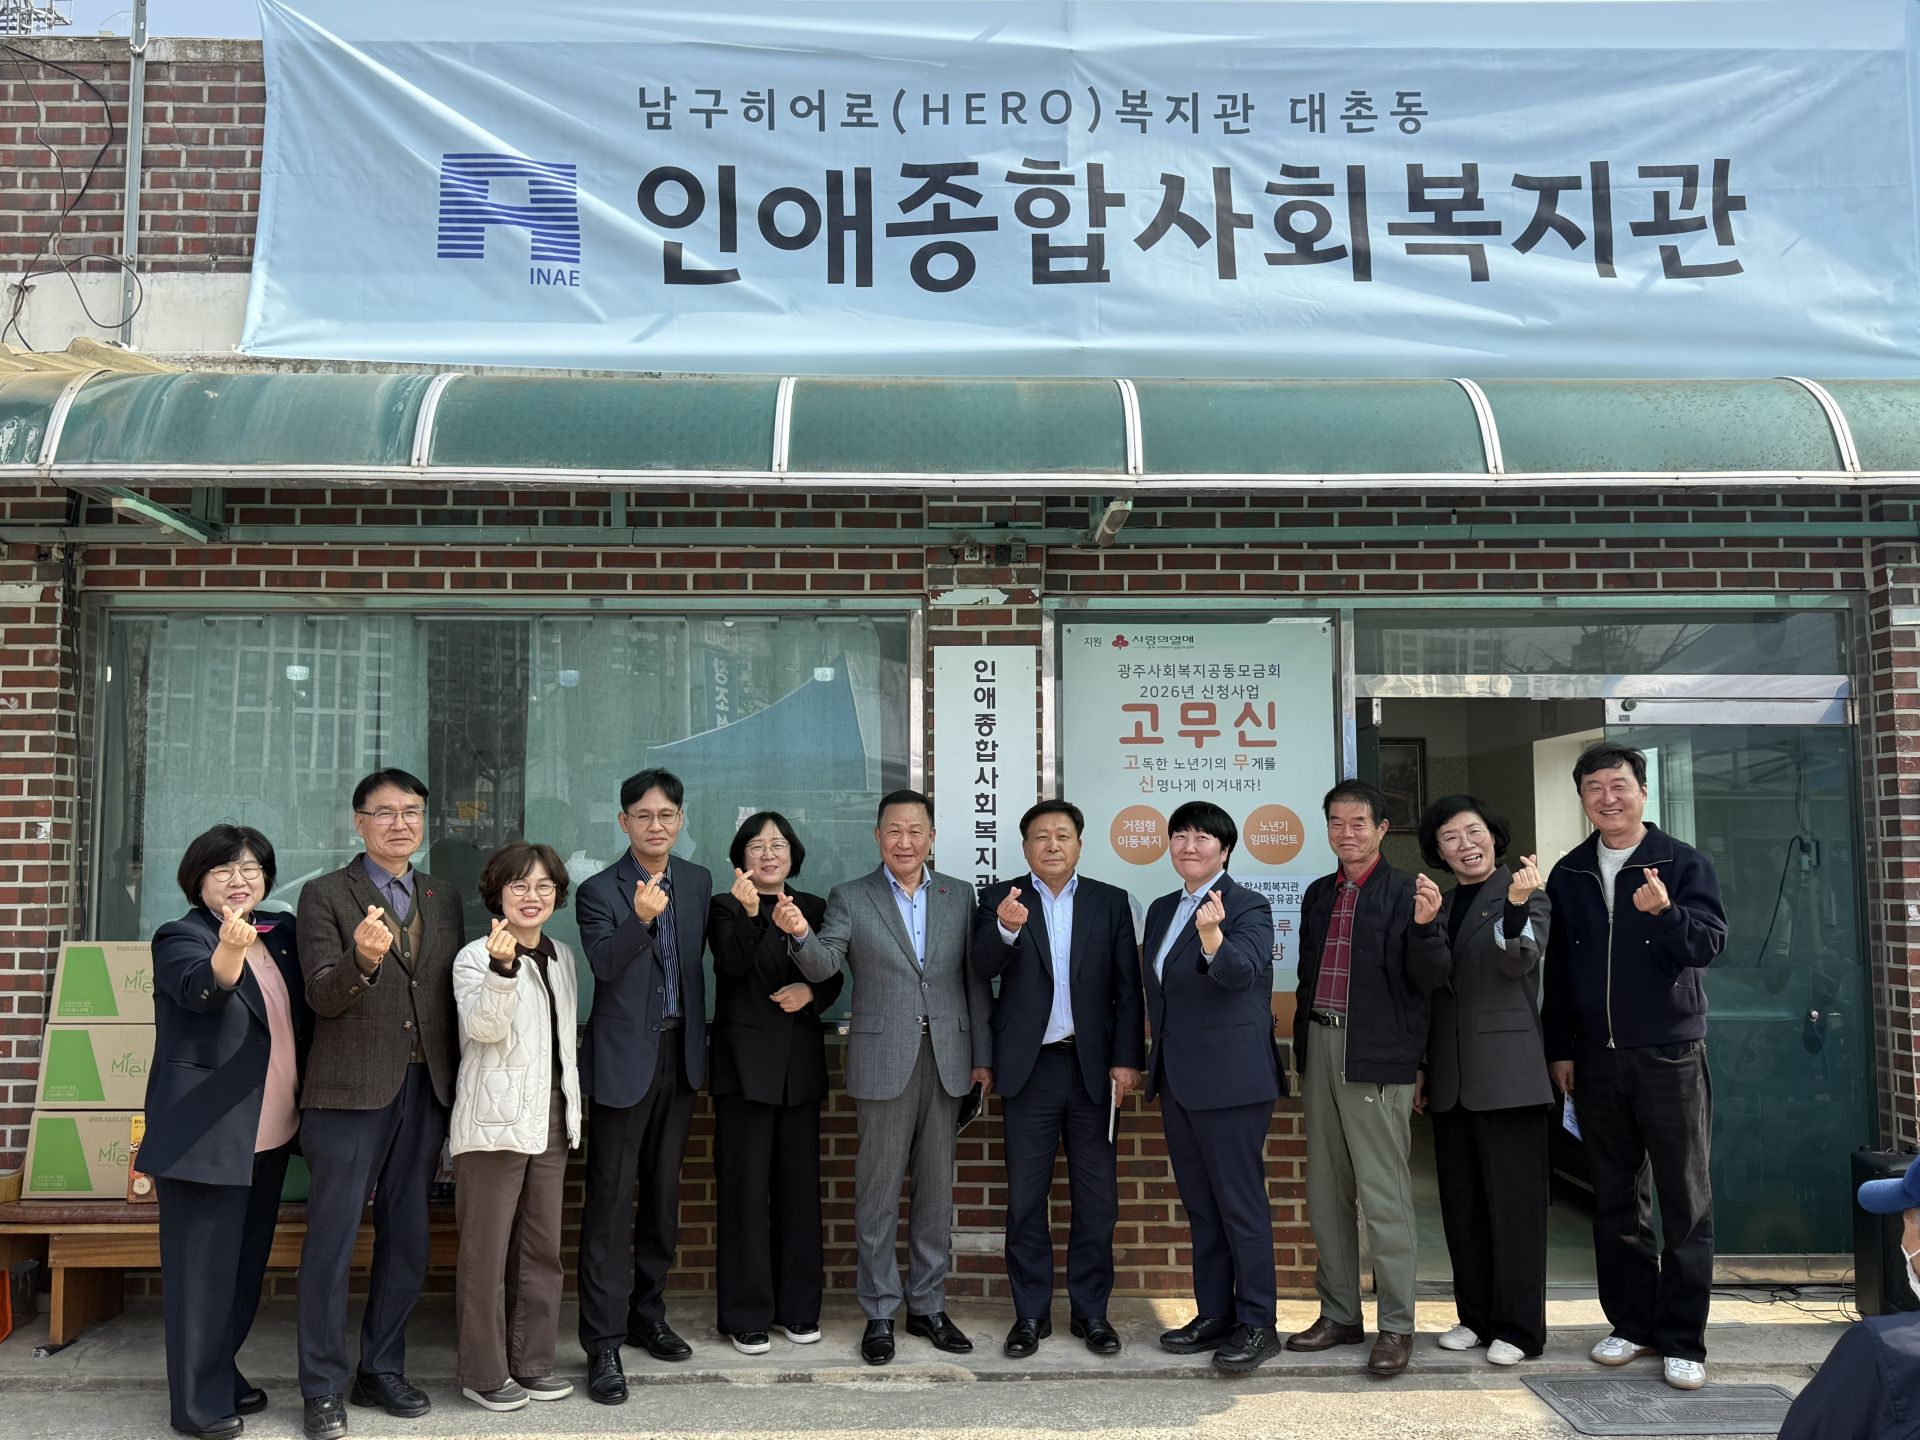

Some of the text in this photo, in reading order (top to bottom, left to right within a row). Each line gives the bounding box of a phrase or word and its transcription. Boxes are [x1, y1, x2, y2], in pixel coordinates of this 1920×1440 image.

[638, 85, 1430, 135] 남구히어로(HERO)복지관 대촌동
[637, 157, 1747, 293] 인애종합사회복지관
[529, 267, 580, 287] INAE
[1084, 635, 1194, 648] 지원 사랑의열매
[1117, 663, 1281, 679] 광주사회복지공동모금회
[1139, 684, 1259, 700] 2026년 신청사업
[1118, 700, 1278, 749] 고무신
[1123, 754, 1276, 772] 고독한 노년기의 무게를
[1138, 775, 1261, 793] 신명나게 이겨내자!
[1122, 819, 1156, 833] 거점형
[1259, 820, 1288, 832] 노년기
[1117, 834, 1162, 848] 이동복지
[1250, 834, 1299, 846] 임파워먼트
[1273, 919, 1293, 937] 루
[125, 969, 153, 993] Mie
[111, 1052, 147, 1077] Miel
[98, 1141, 128, 1166] Mie
